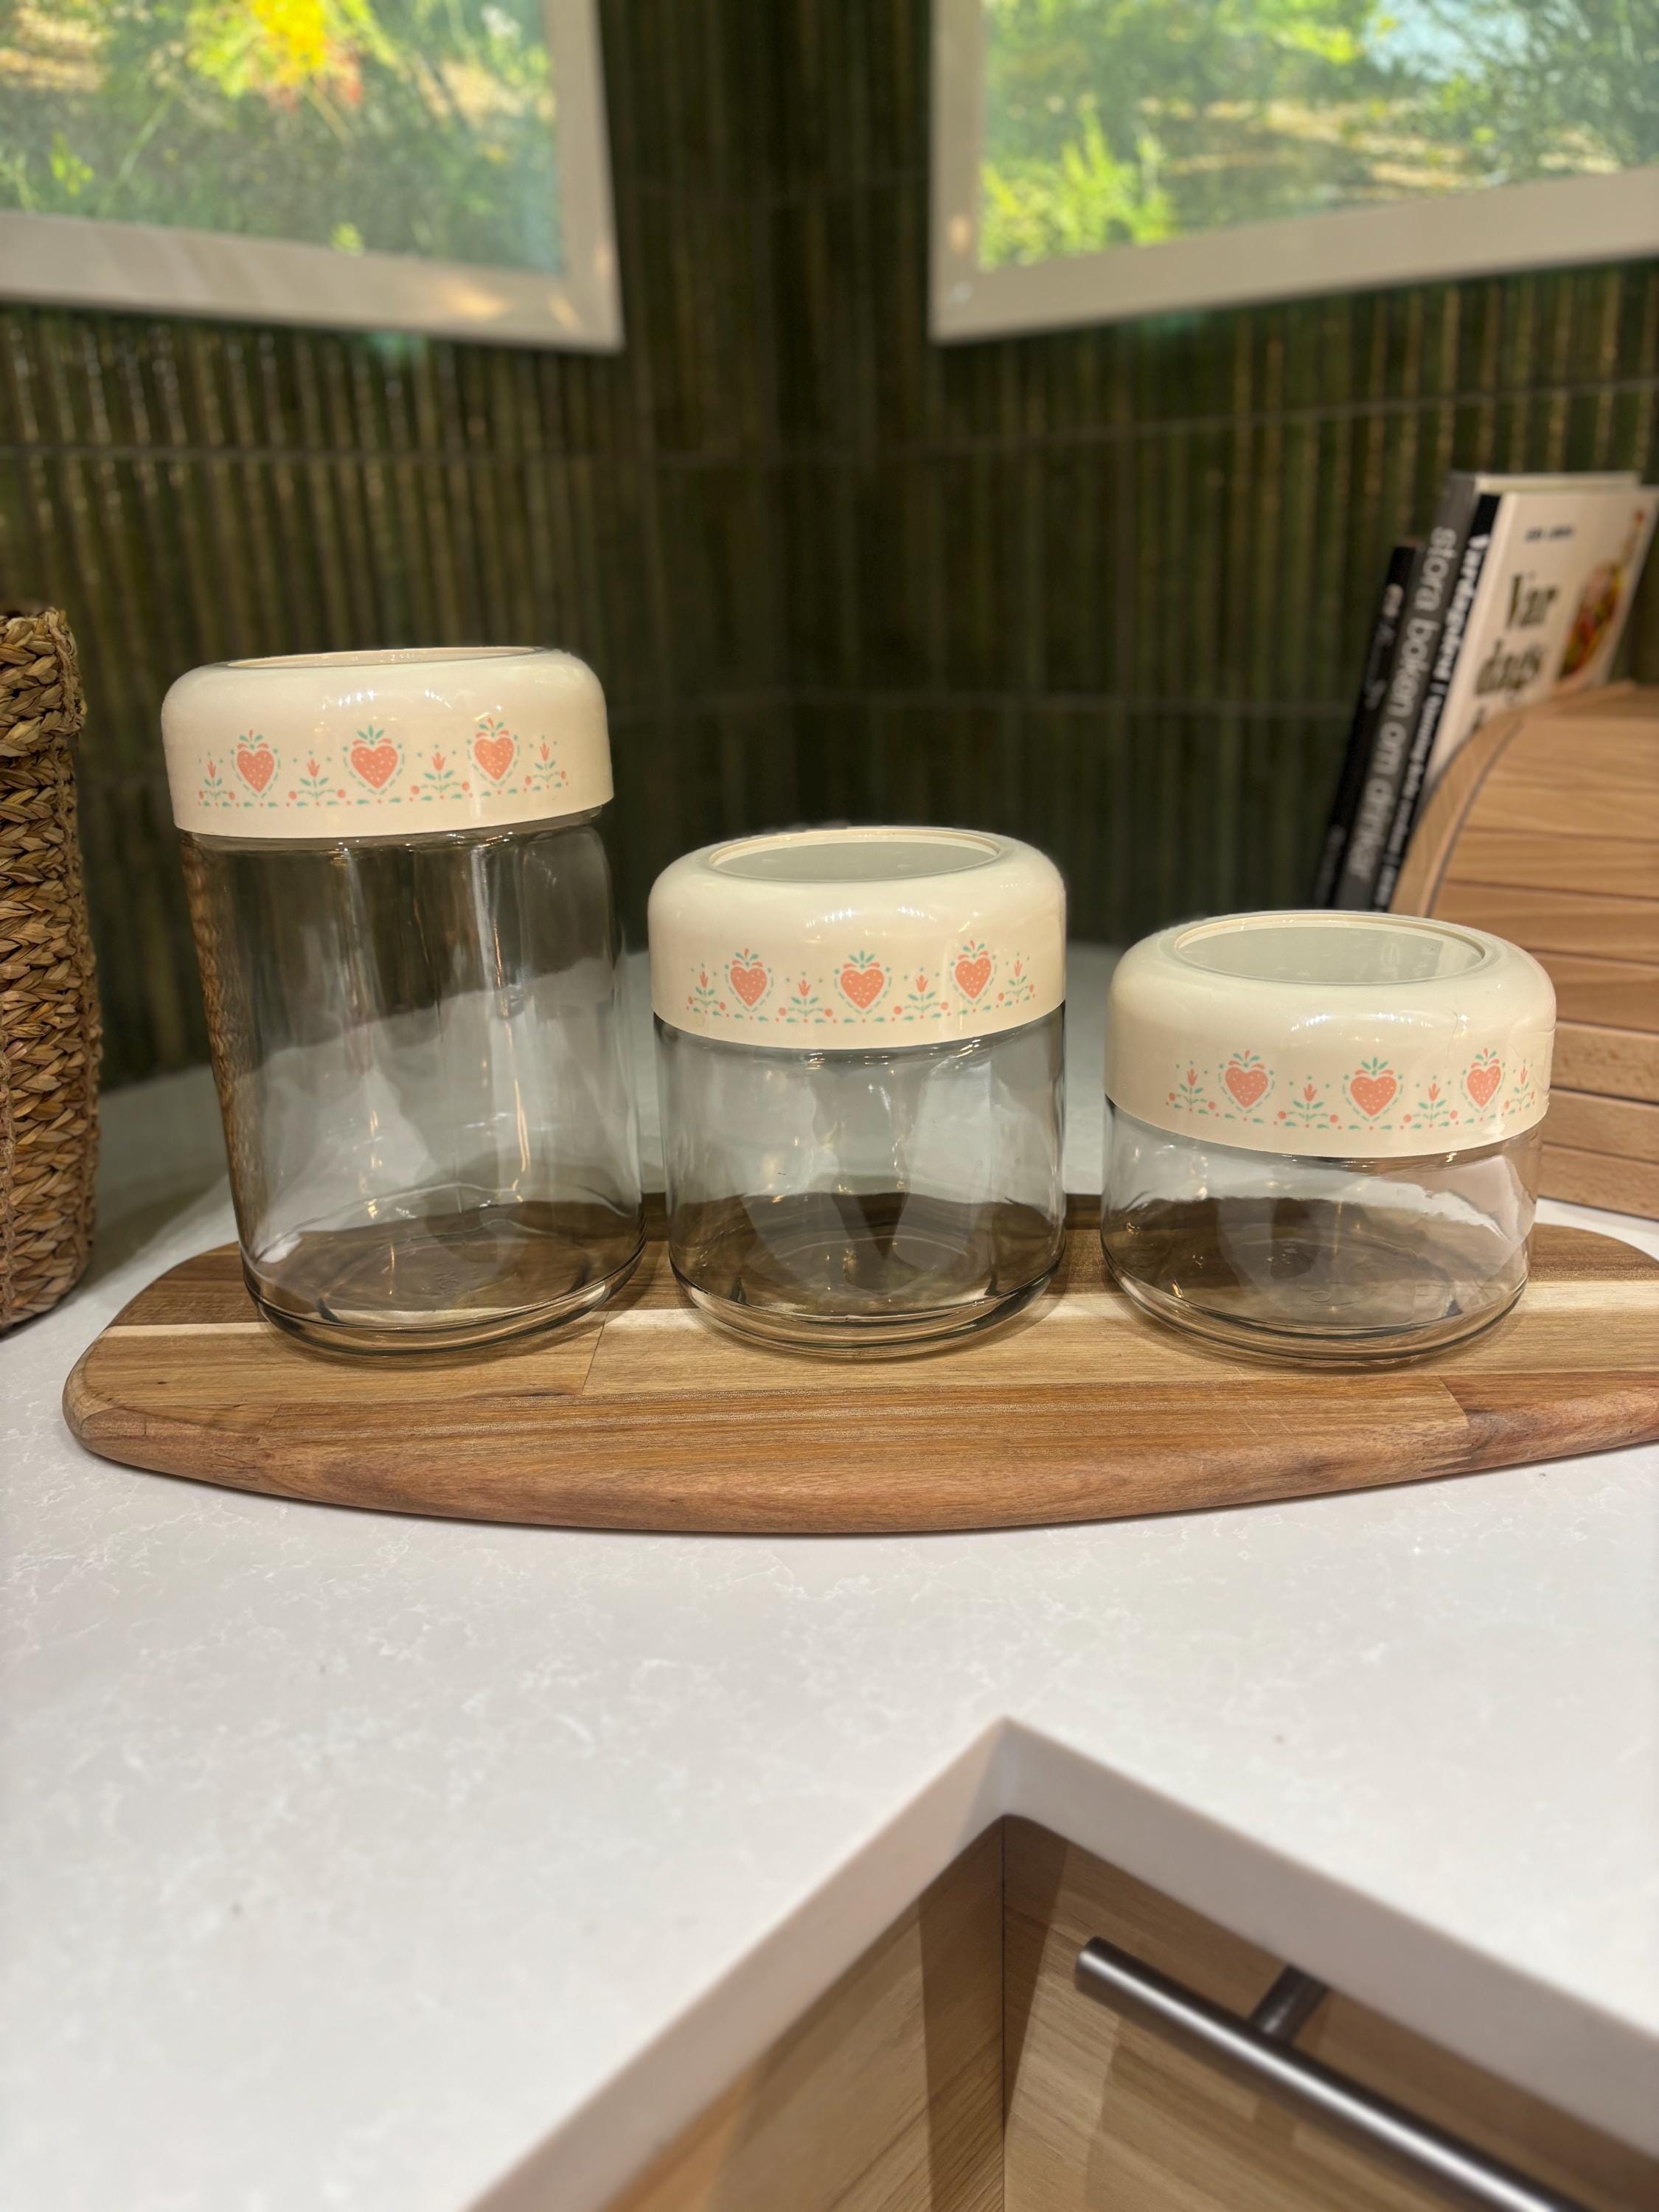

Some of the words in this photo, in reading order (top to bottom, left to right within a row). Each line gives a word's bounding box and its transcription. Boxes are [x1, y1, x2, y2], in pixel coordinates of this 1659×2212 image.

[1414, 526, 1457, 611] stora
[1386, 617, 1439, 717] boken
[1372, 721, 1407, 774] om
